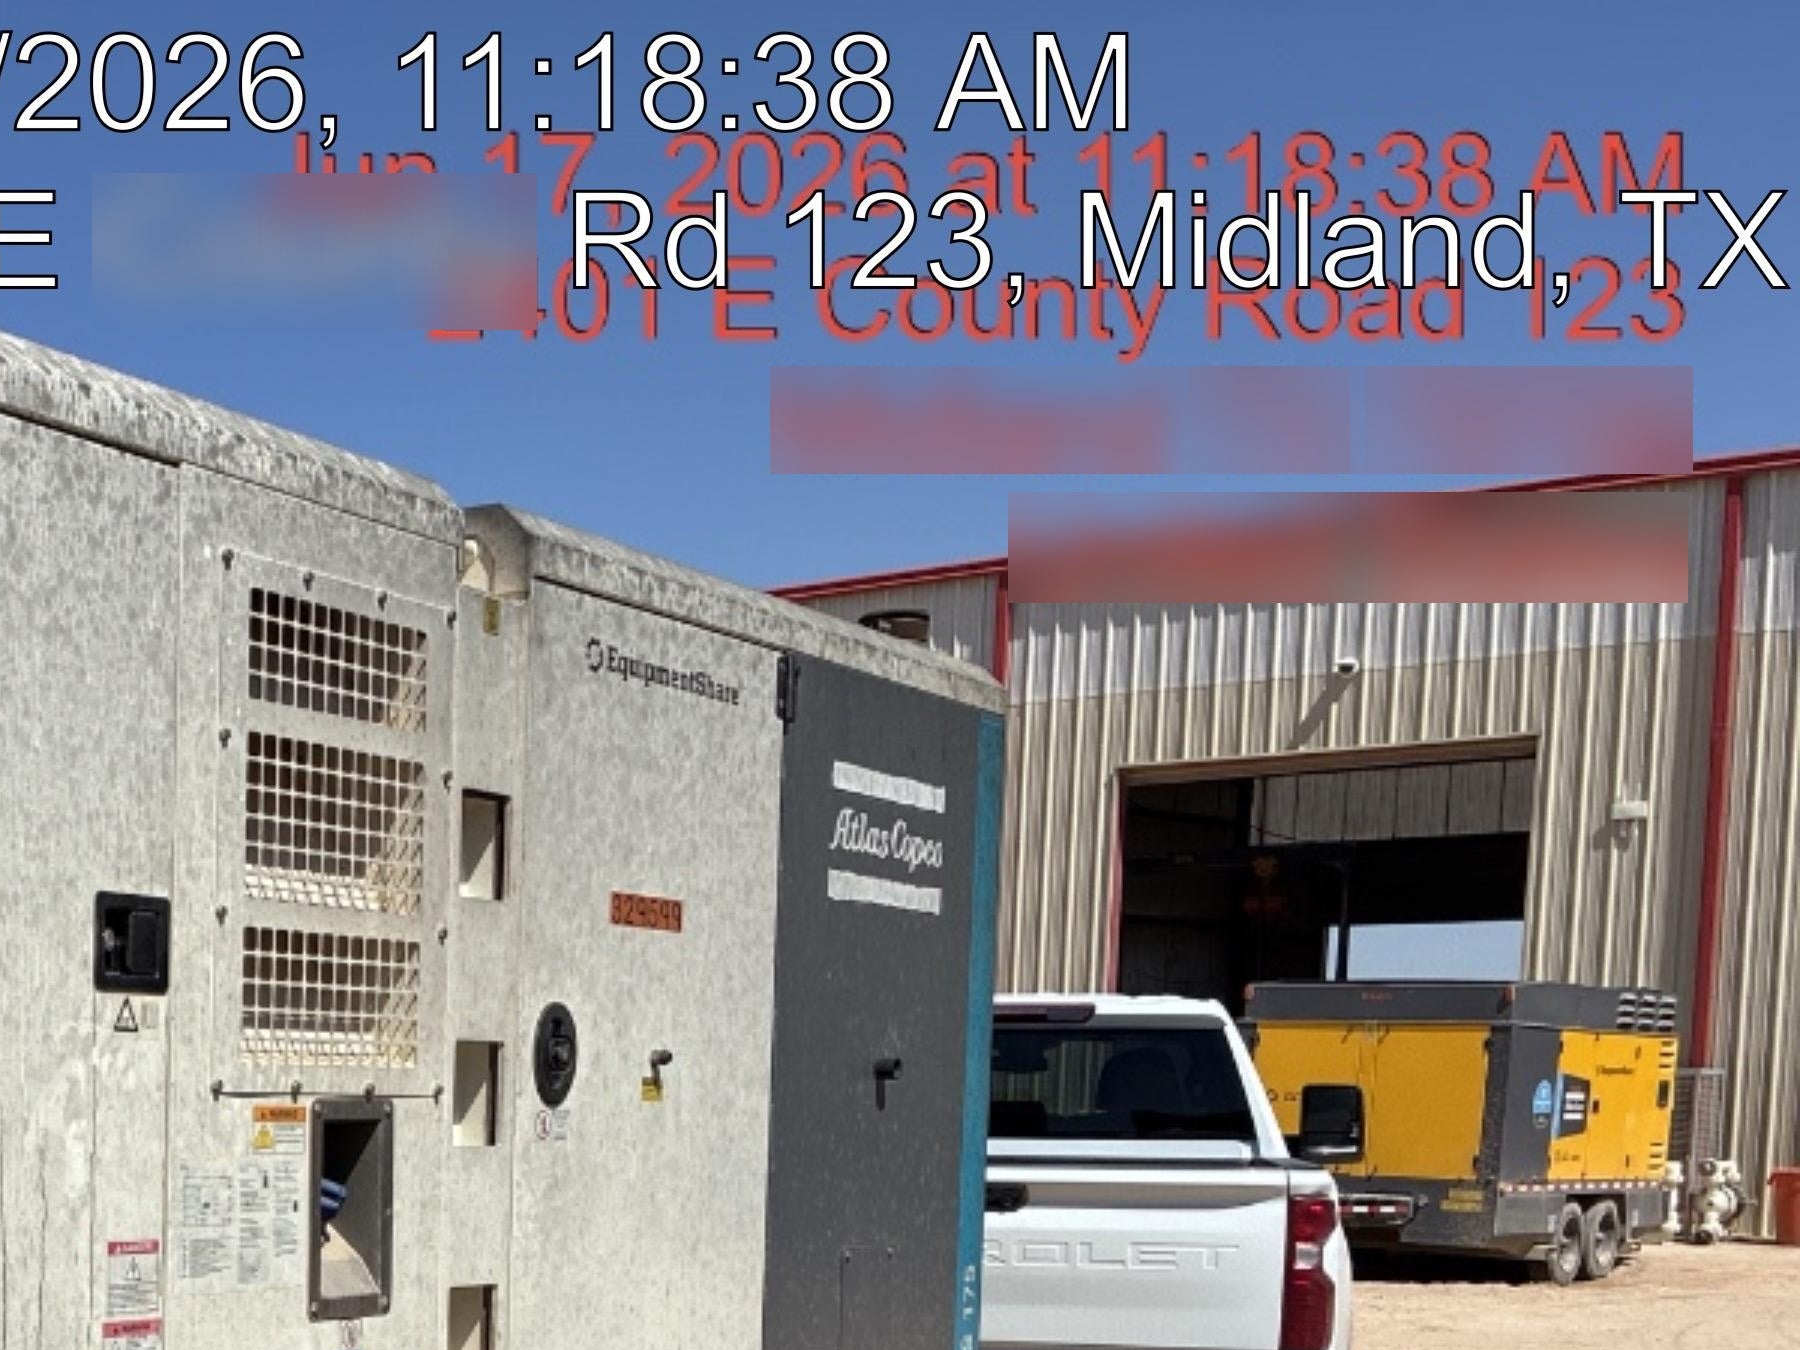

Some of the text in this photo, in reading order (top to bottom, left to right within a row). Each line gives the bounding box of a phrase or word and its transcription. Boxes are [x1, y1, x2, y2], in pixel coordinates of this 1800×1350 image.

[606, 643, 739, 706] EquipmentShare
[828, 806, 943, 873] Atlas Copco
